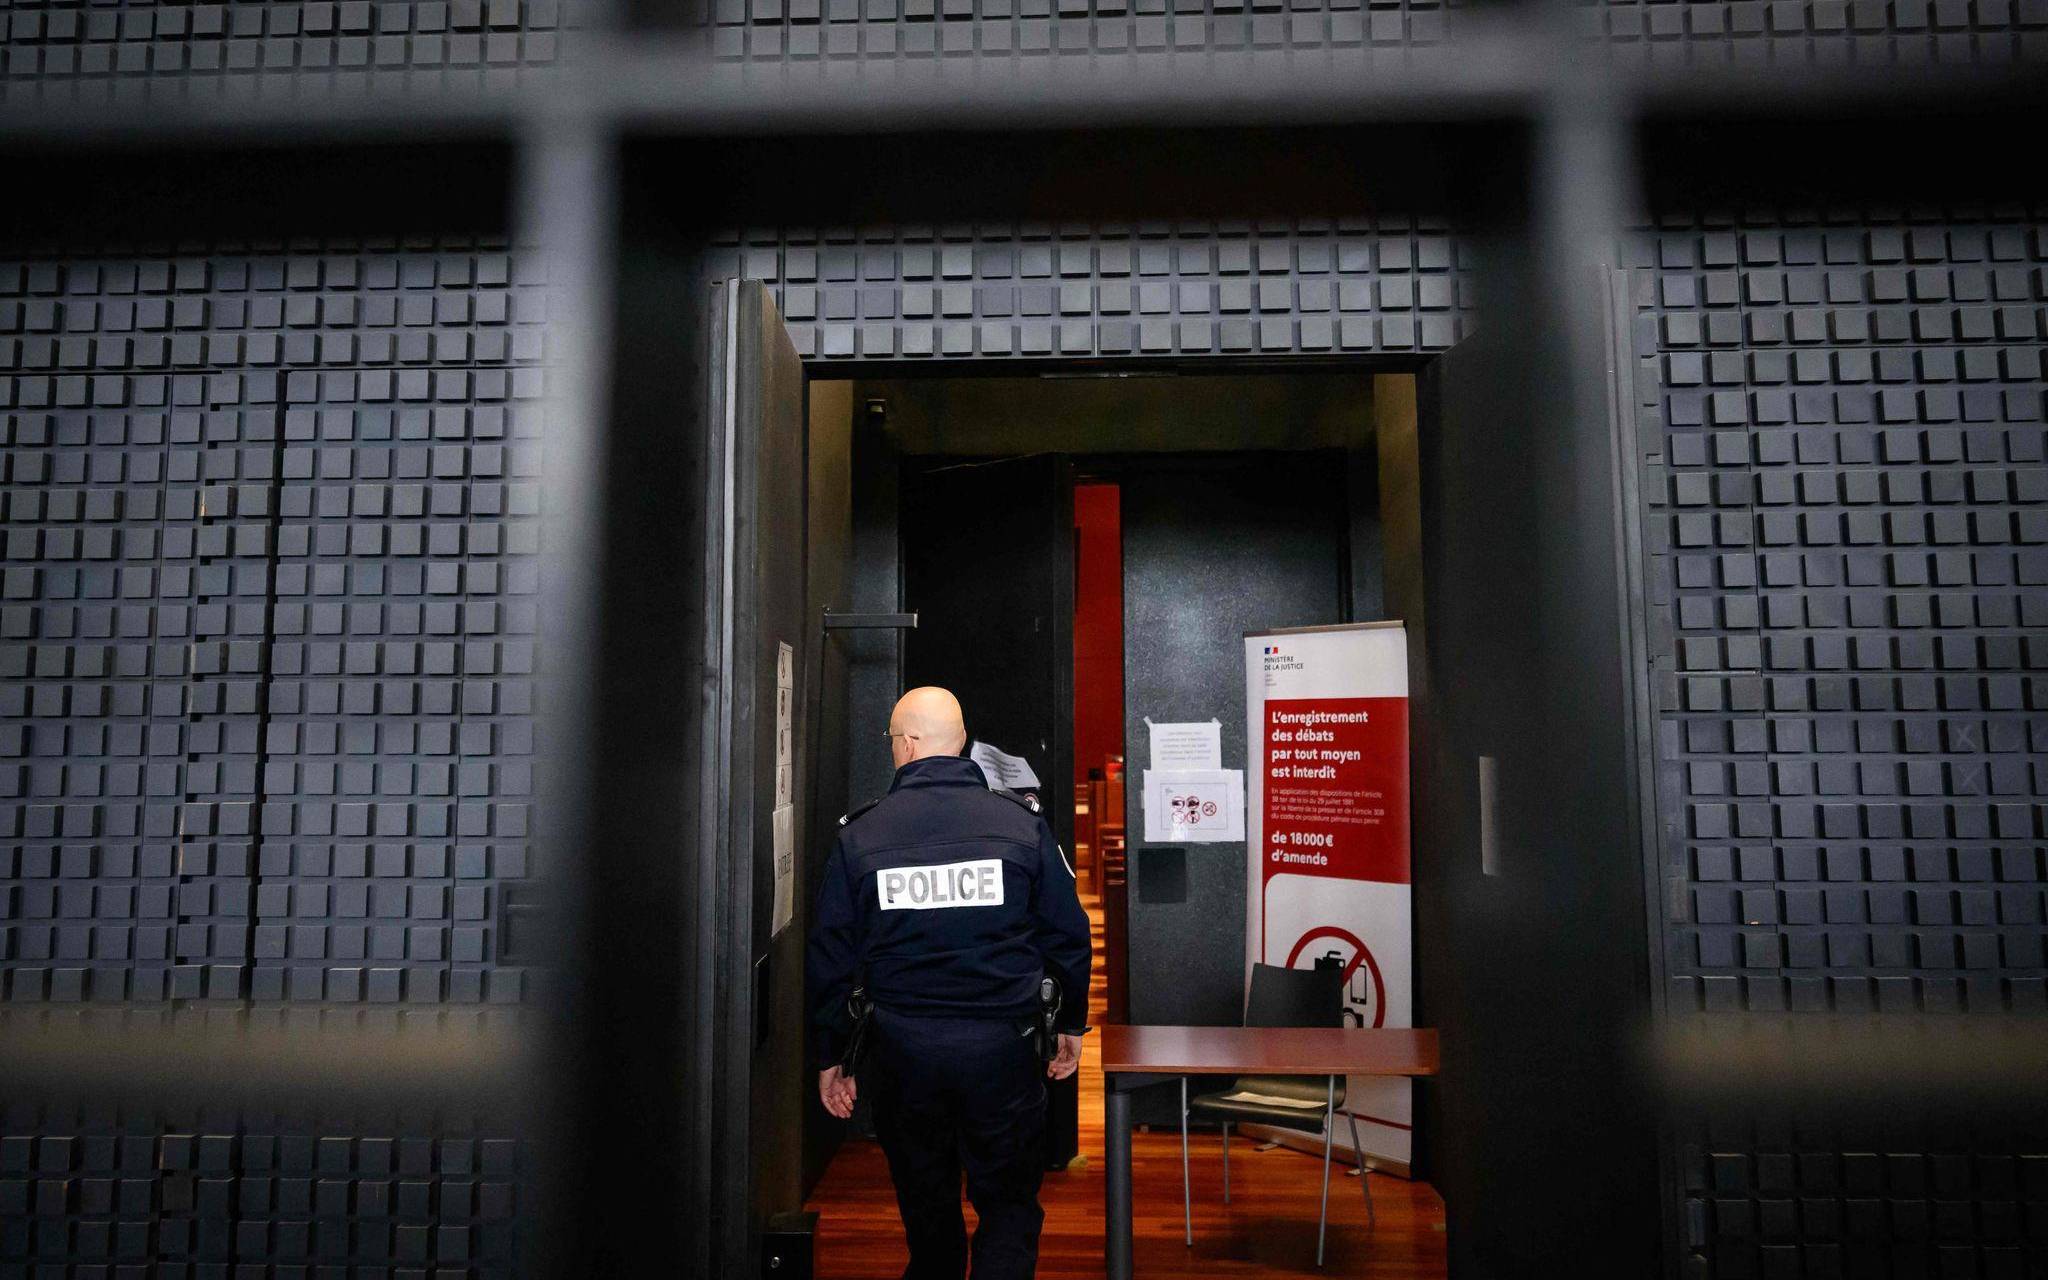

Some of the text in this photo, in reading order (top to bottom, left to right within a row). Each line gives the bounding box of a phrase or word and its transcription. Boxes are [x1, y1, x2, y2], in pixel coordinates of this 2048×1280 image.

[1280, 663, 1304, 671] JUSTICE
[1272, 710, 1368, 726] L'enregistrement
[1272, 729, 1334, 741] des débats
[1272, 748, 1361, 764] par tout moyen
[1271, 764, 1336, 779] est interdit
[1271, 830, 1287, 844] de
[1271, 849, 1328, 866] d'amende
[886, 867, 996, 904] POLICE
